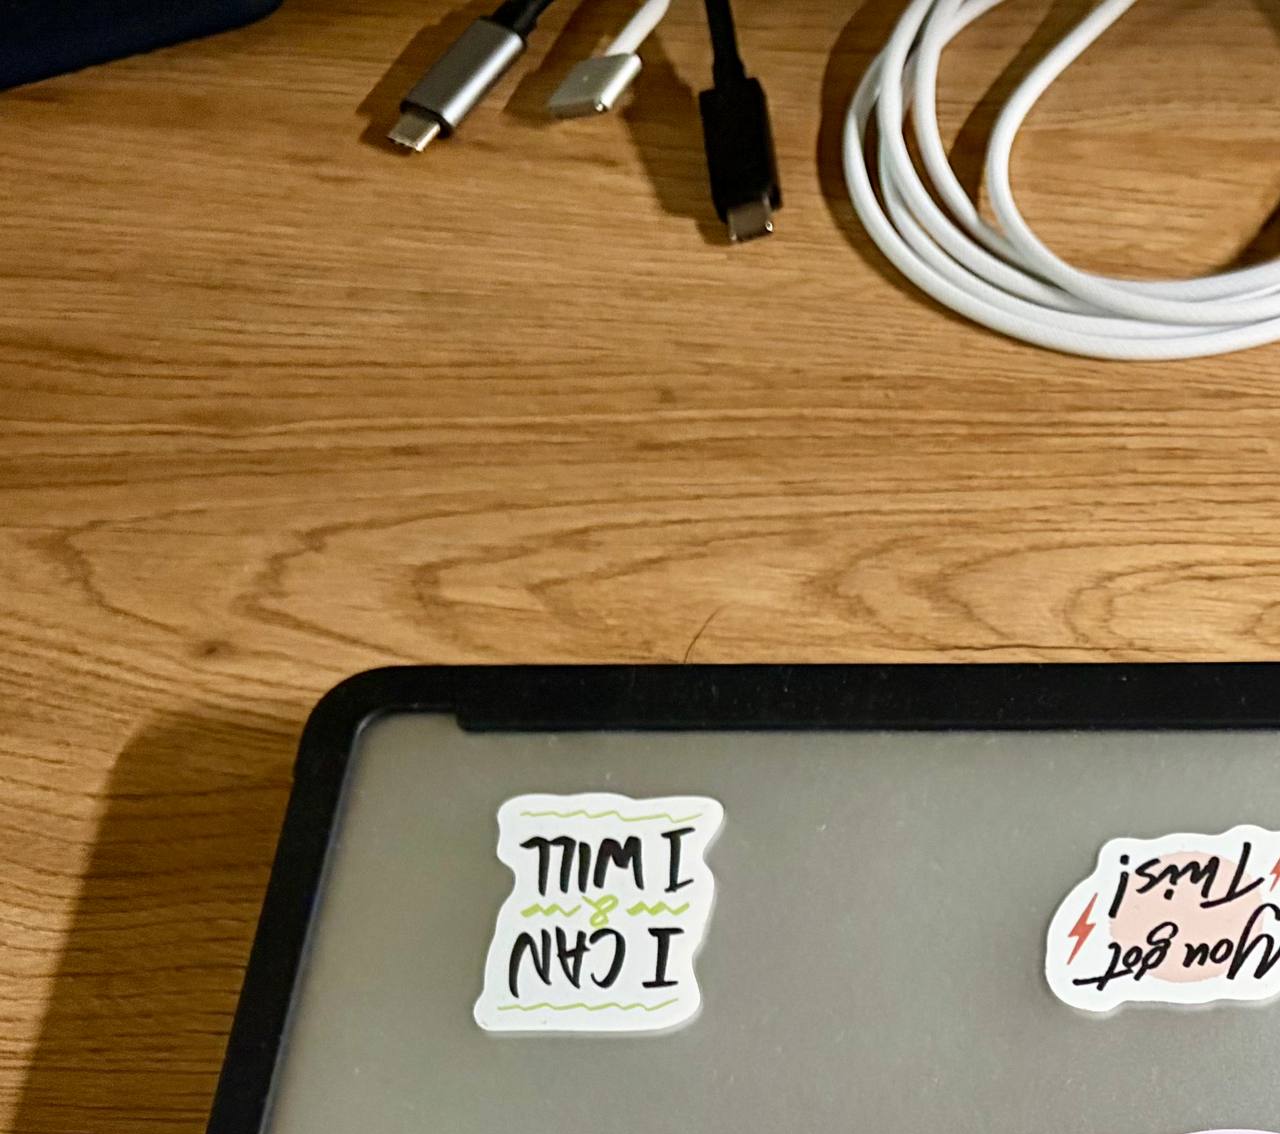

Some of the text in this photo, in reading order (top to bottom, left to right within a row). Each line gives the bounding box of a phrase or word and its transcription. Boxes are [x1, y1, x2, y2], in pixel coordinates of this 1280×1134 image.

[519, 827, 696, 896] I WILL
[1108, 842, 1265, 919] This!
[508, 926, 684, 998] I CAN
[1072, 921, 1179, 991] got
